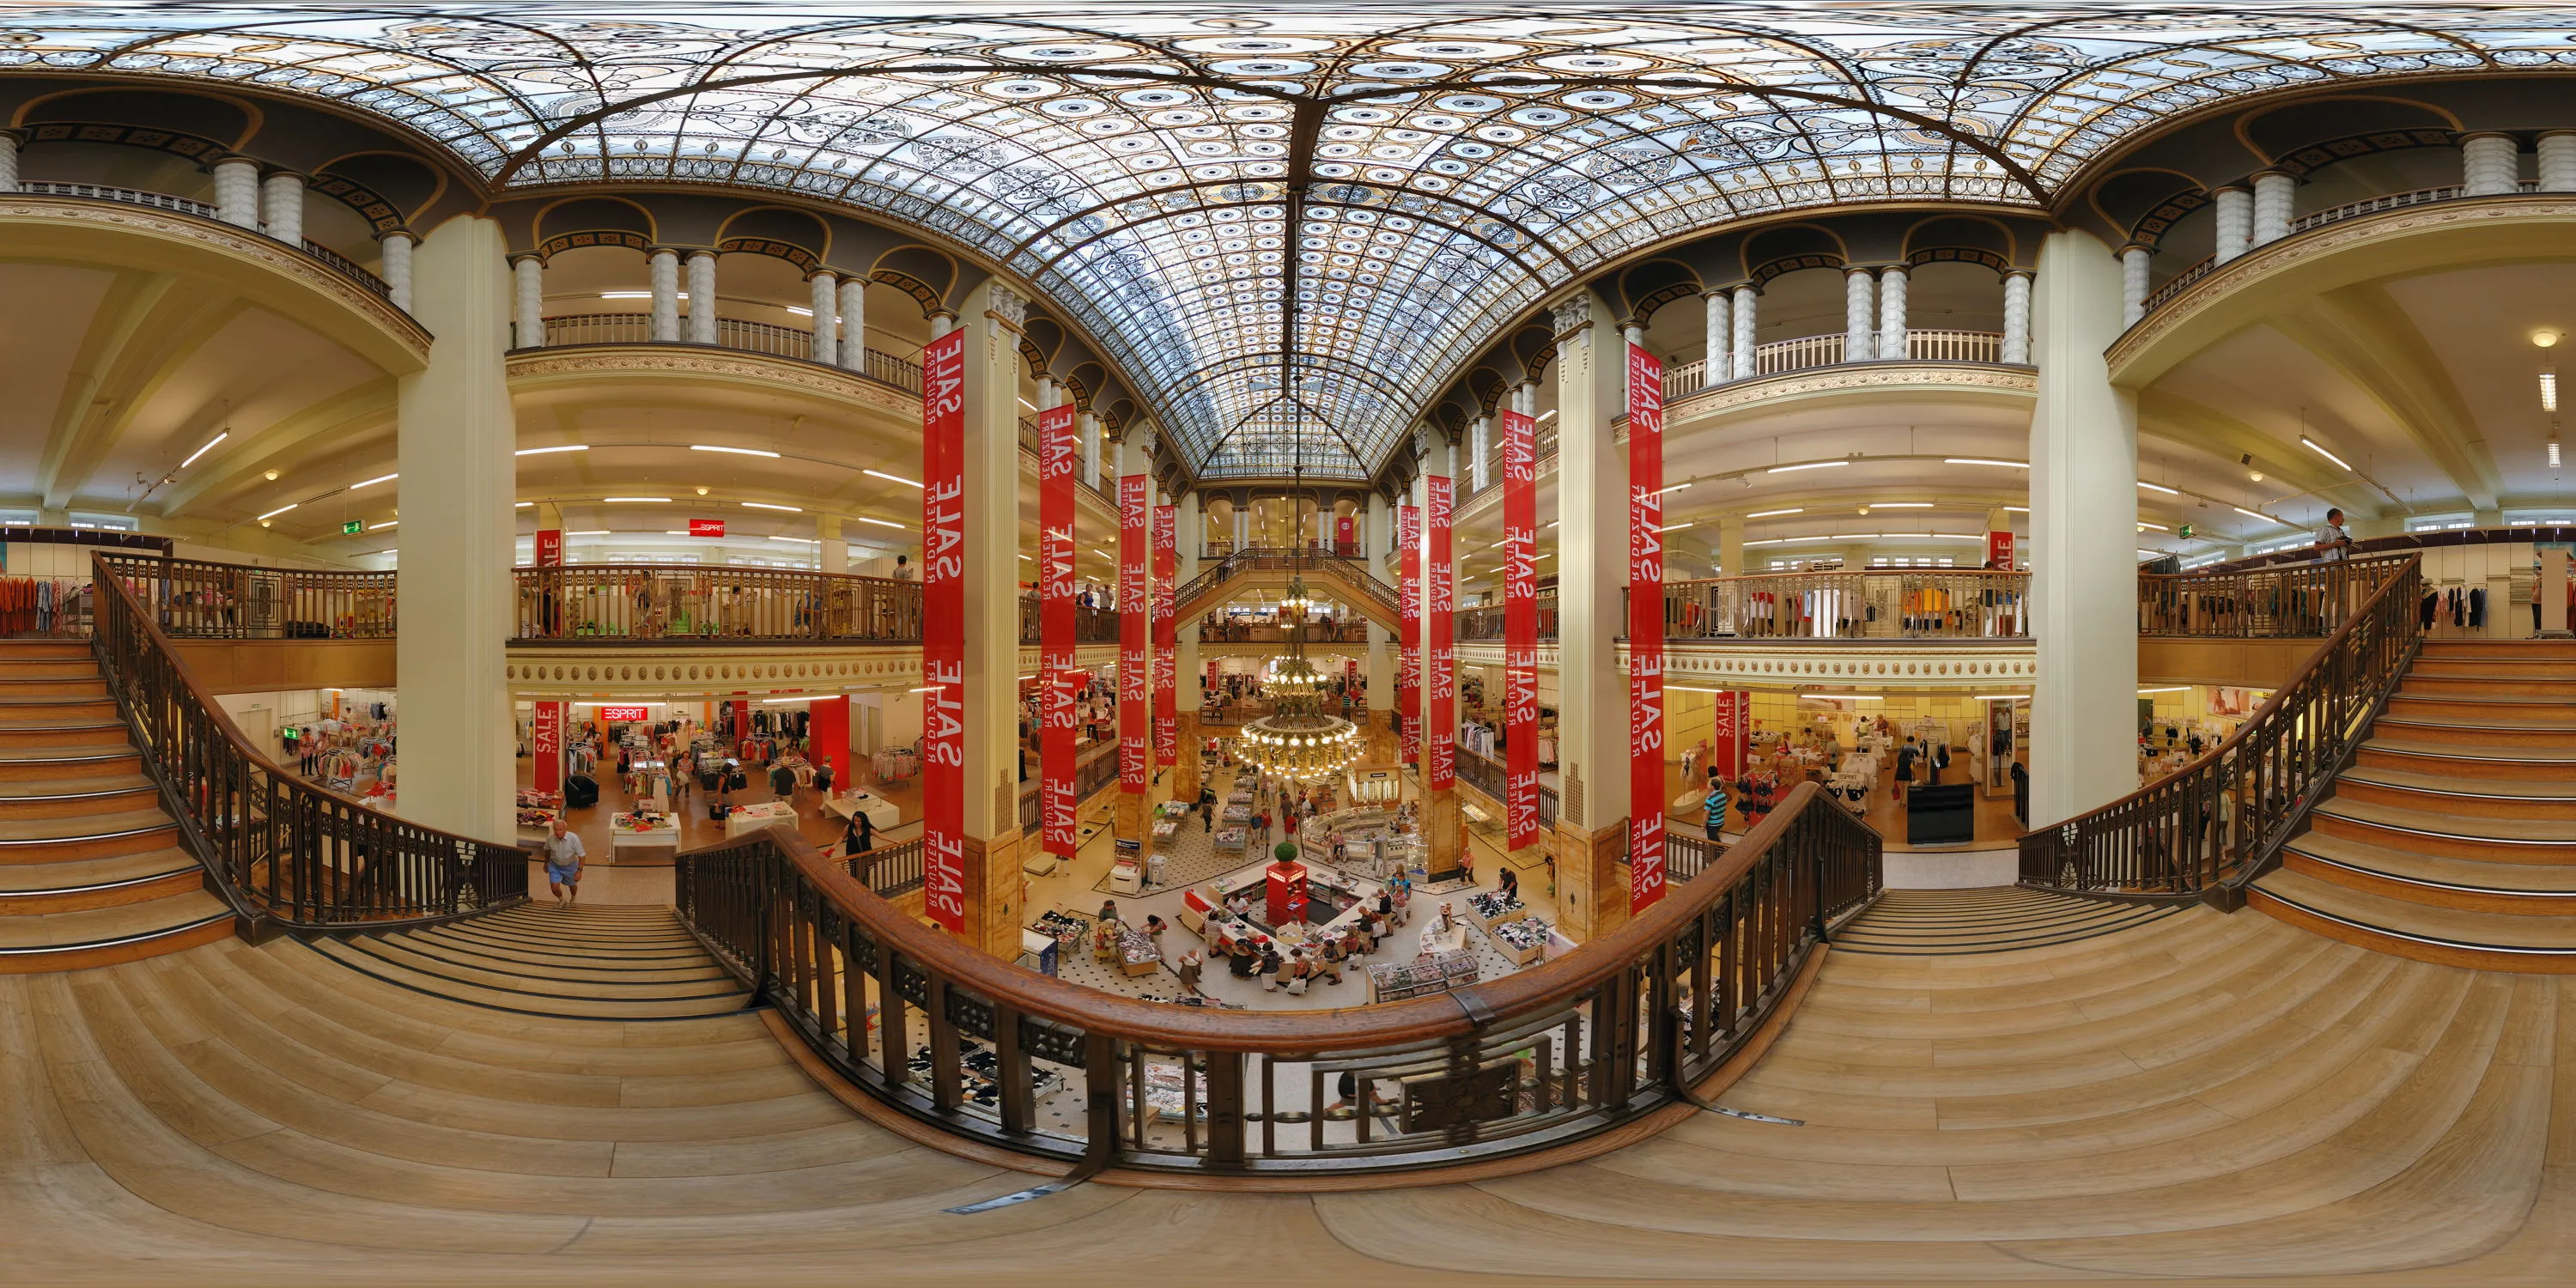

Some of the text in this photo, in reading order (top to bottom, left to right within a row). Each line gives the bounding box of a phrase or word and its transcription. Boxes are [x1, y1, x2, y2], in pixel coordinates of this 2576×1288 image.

[544, 538, 558, 570] ALE
[537, 709, 551, 753] SALE
[605, 708, 644, 720] ESPRIT
[1717, 699, 1728, 738] SALE
